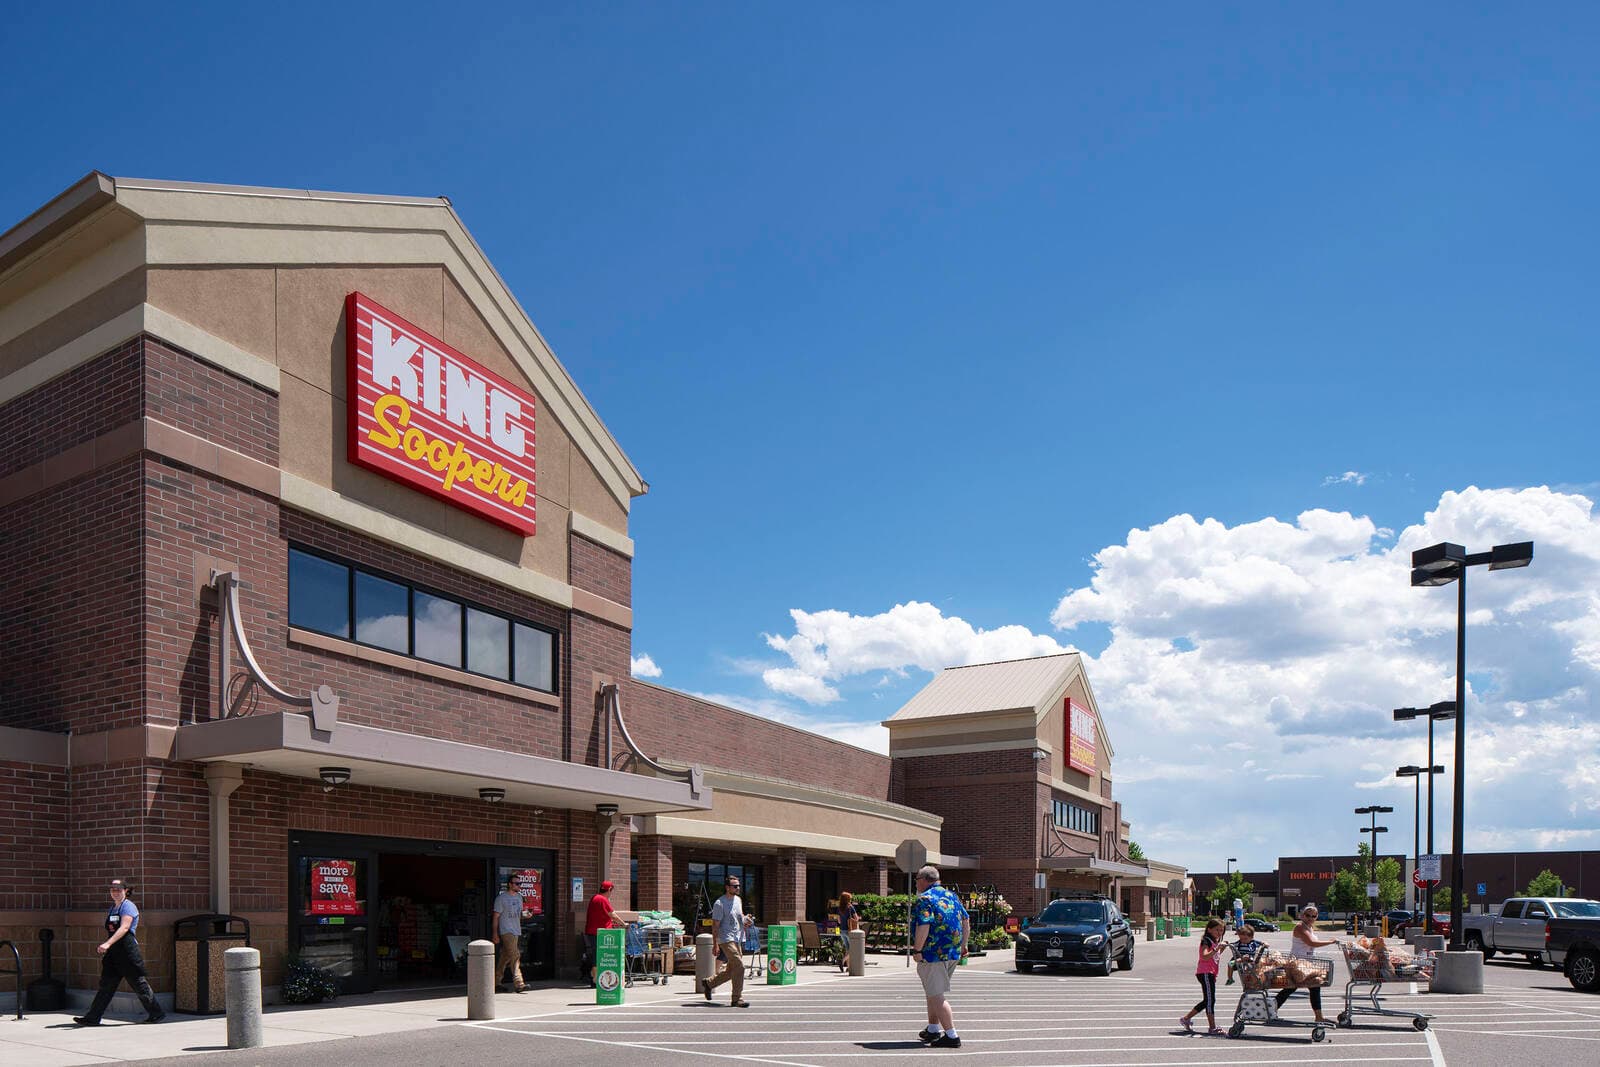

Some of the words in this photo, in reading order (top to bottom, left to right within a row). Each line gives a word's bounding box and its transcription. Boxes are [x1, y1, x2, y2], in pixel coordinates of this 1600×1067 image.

[372, 318, 525, 458] KING
[368, 393, 529, 508] Soopers
[319, 866, 349, 876] more
[1290, 872, 1315, 880] HOME
[319, 883, 349, 894] save
